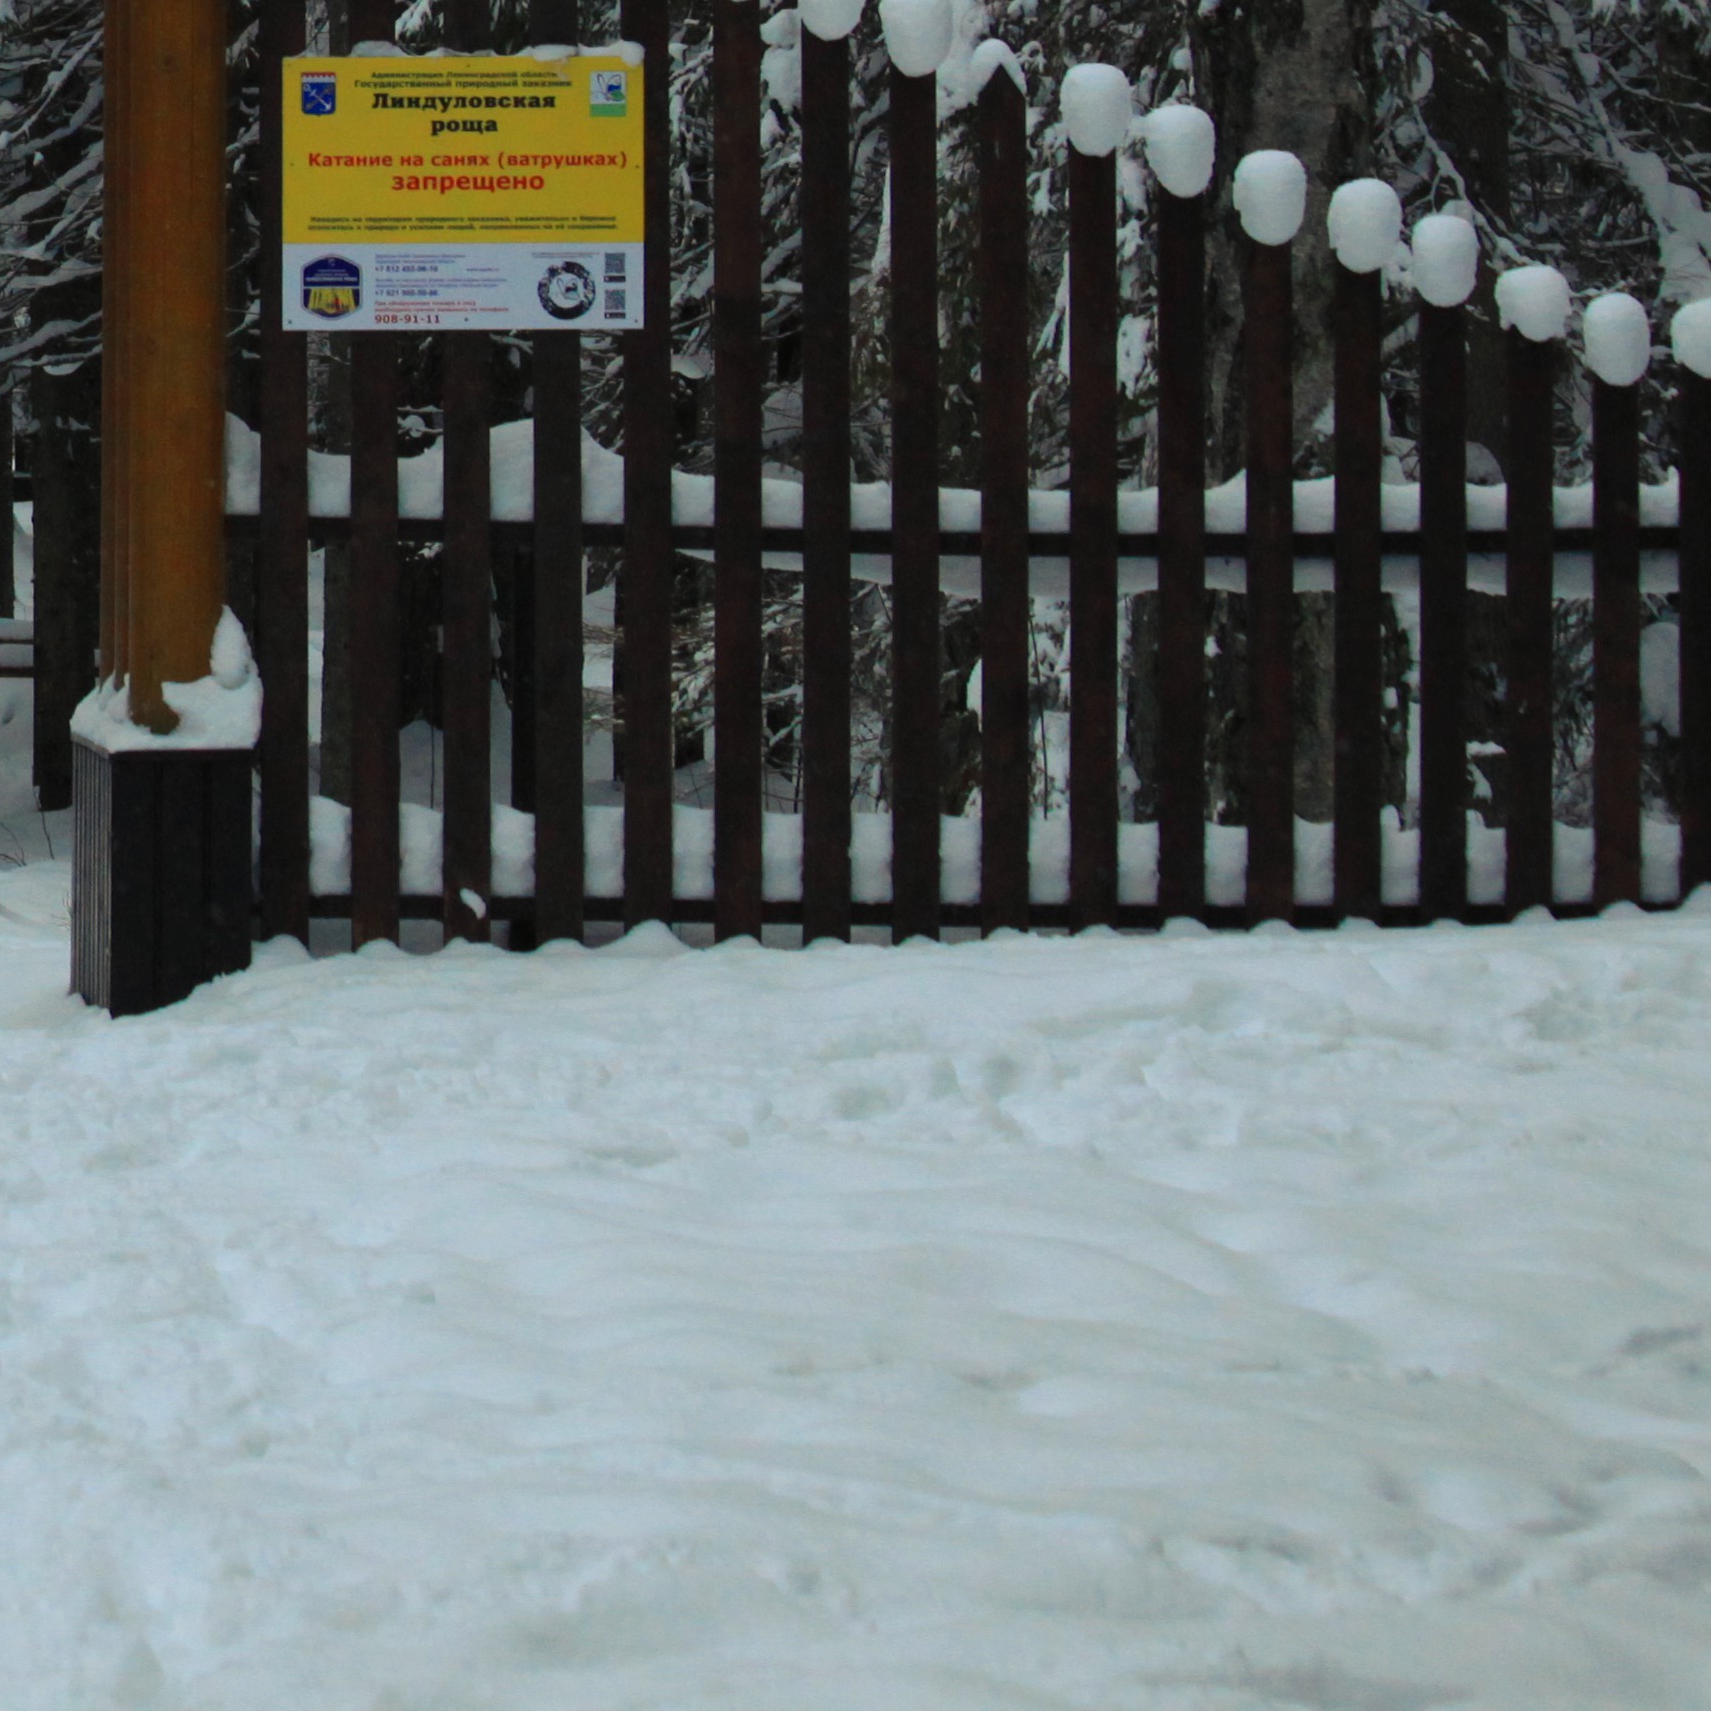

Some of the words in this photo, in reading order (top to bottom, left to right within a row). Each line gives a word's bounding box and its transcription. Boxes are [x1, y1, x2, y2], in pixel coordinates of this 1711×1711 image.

[372, 93, 556, 112] Линдуловская
[430, 119, 498, 135] роща
[308, 152, 393, 168] Катание
[400, 155, 424, 167] на
[431, 155, 490, 167] санях
[497, 151, 628, 171] (ватрушках)
[391, 174, 545, 195] запрещено
[374, 314, 441, 324] 908-91-11
